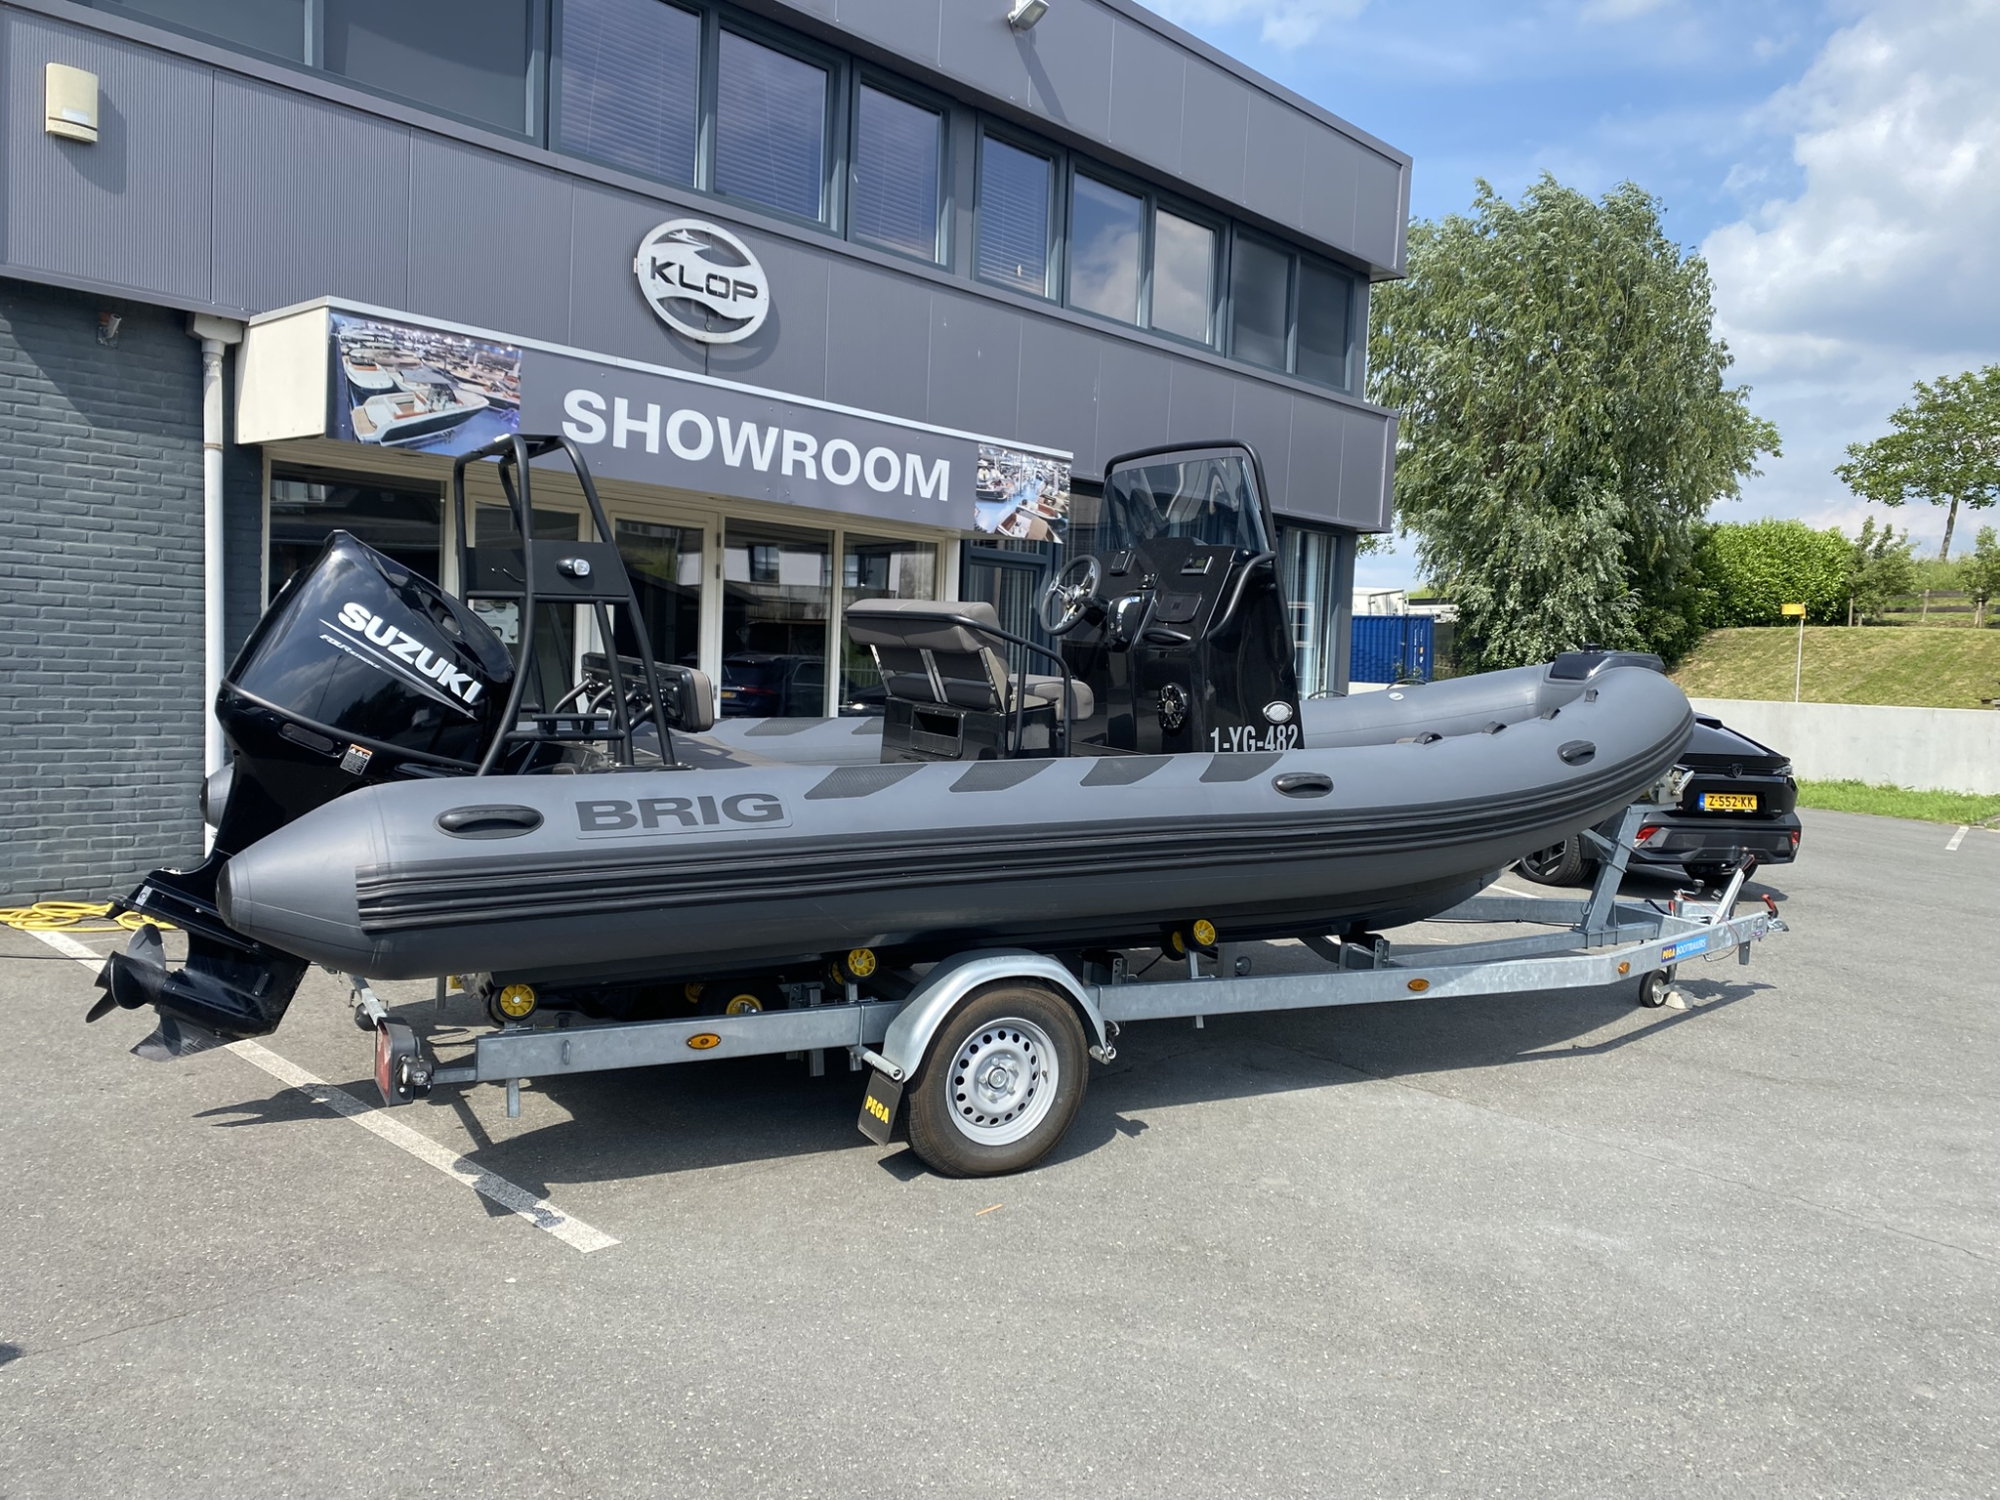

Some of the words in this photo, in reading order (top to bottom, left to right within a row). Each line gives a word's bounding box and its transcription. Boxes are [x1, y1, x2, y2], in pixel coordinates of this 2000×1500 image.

[650, 256, 758, 302] KLOP
[562, 389, 950, 502] SHOWROOM
[338, 602, 482, 704] SUZUKI
[1210, 724, 1298, 753] 1-YG-482
[575, 793, 784, 831] BRIG
[865, 1095, 889, 1124] PEGA
